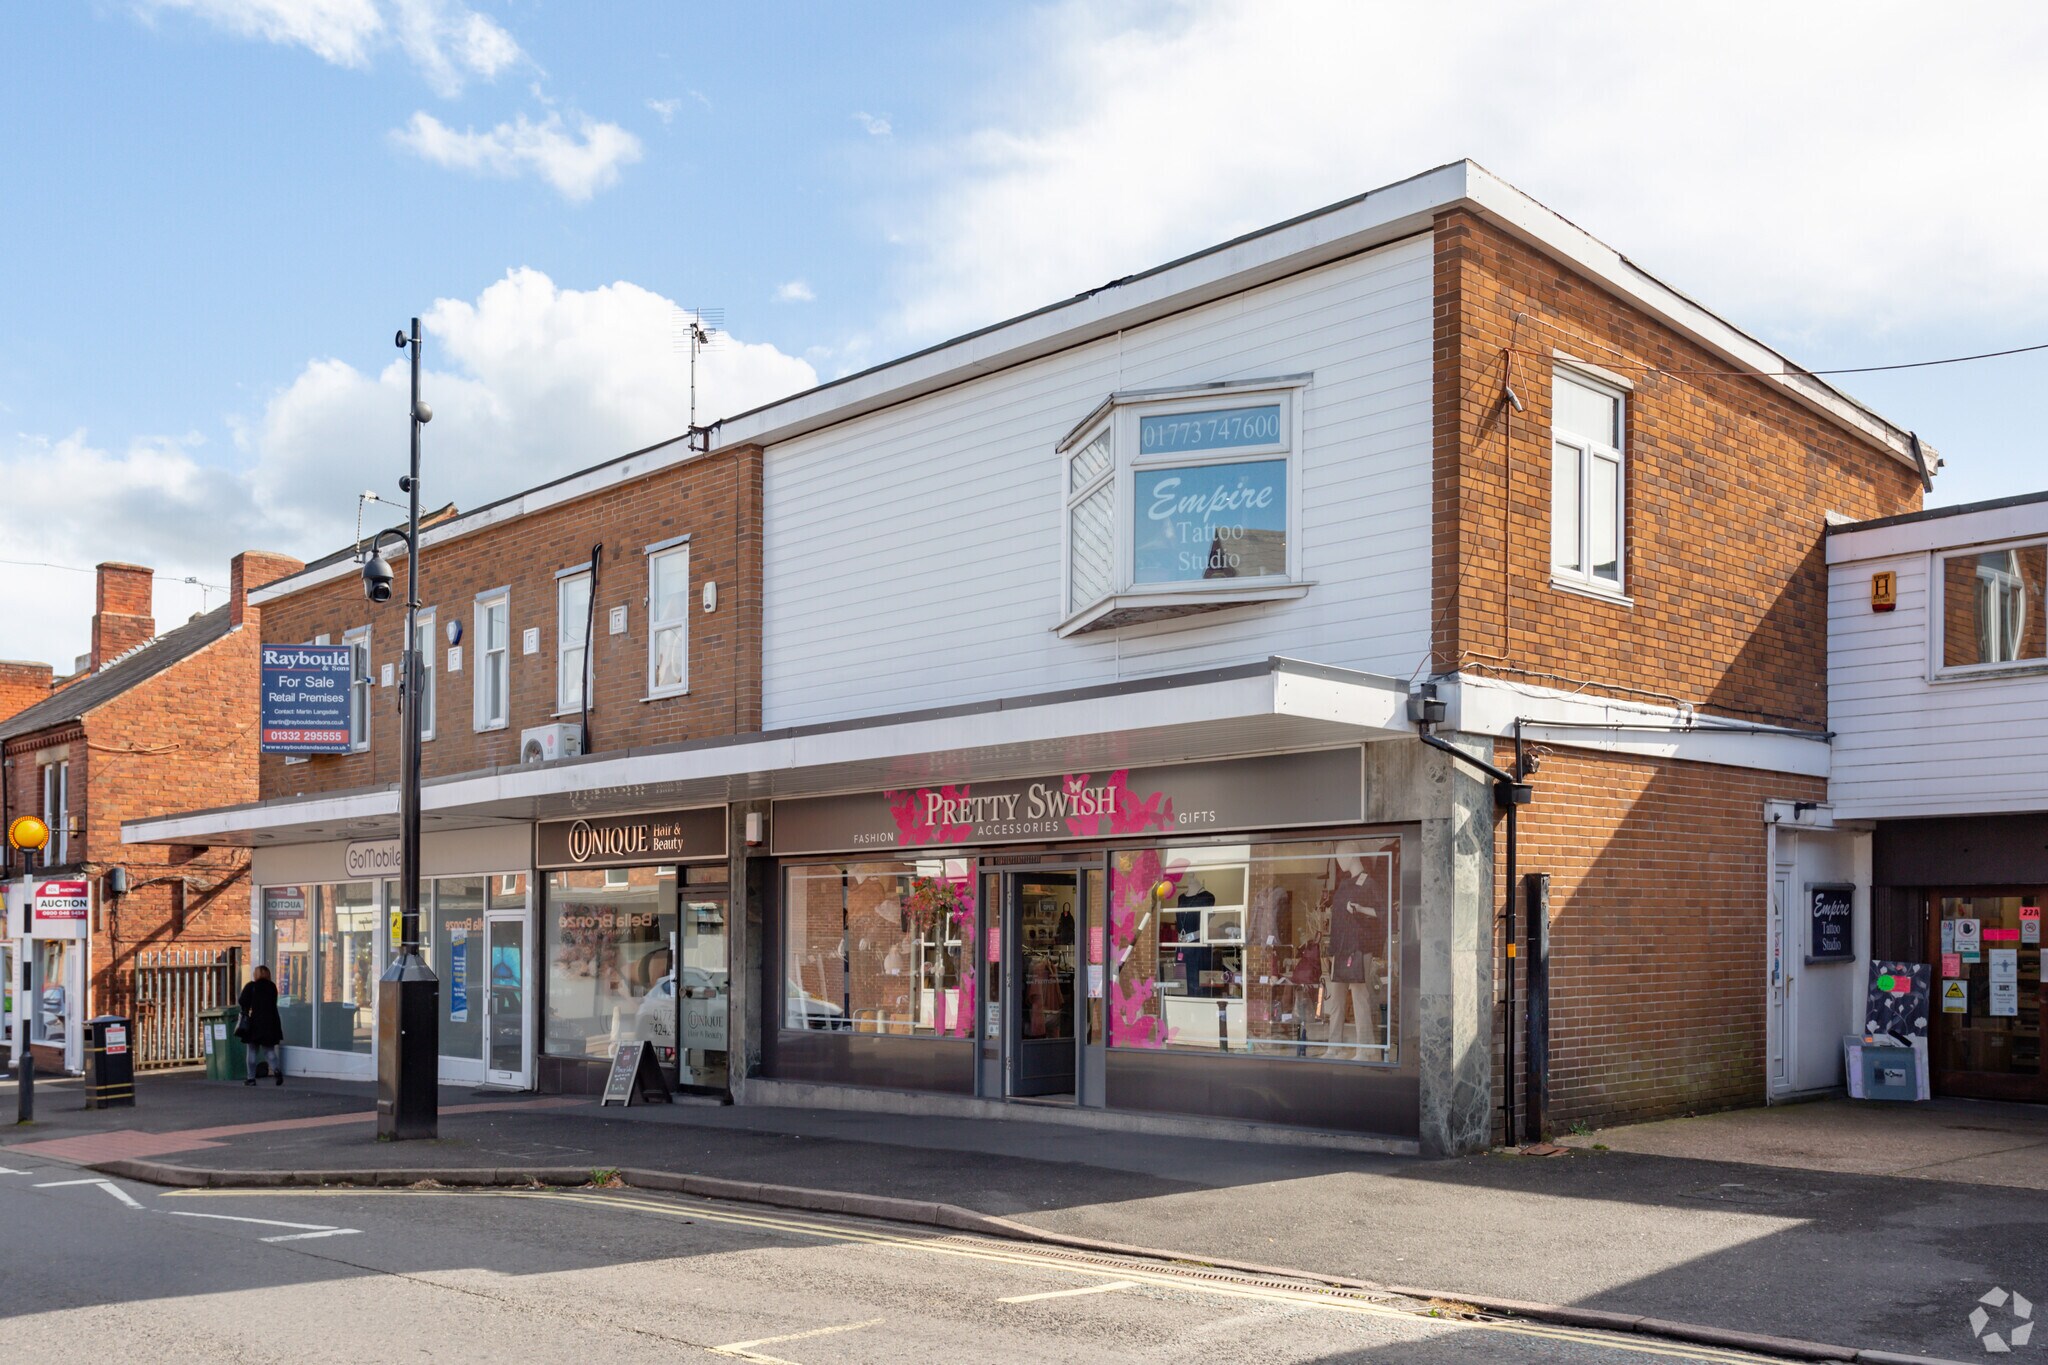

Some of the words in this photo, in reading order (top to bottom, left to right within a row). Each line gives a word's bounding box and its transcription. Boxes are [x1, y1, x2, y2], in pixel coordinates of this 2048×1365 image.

[1143, 420, 1202, 447] 01773
[1207, 414, 1279, 441] 747600
[1148, 477, 1273, 522] Empire
[1176, 521, 1244, 544] Tattoo
[1178, 548, 1240, 571] Studio
[264, 650, 350, 669] Raybould
[279, 676, 301, 687] For
[305, 676, 334, 688] Sale
[269, 692, 296, 702] Retail
[299, 693, 344, 703] Premises
[271, 731, 301, 740] 01332
[304, 732, 342, 741] 295555
[925, 792, 1020, 826] PRETTY
[1027, 780, 1117, 820] SWISH
[1179, 810, 1216, 824] GIFTS
[653, 824, 672, 837] Hair
[673, 822, 681, 836] &
[977, 820, 1059, 836] ACCESSORIES
[568, 819, 648, 862] UNIQUE
[653, 837, 684, 853] Beauty
[853, 832, 894, 844] FASHION
[349, 845, 401, 869] GoMobile
[40, 899, 87, 908] AUCTION
[1813, 893, 1850, 921] Empire
[2022, 908, 2039, 917] 22A
[1822, 921, 1841, 934] Tattoo
[1822, 937, 1841, 950] Studio
[688, 1010, 724, 1030] UNIQUE
